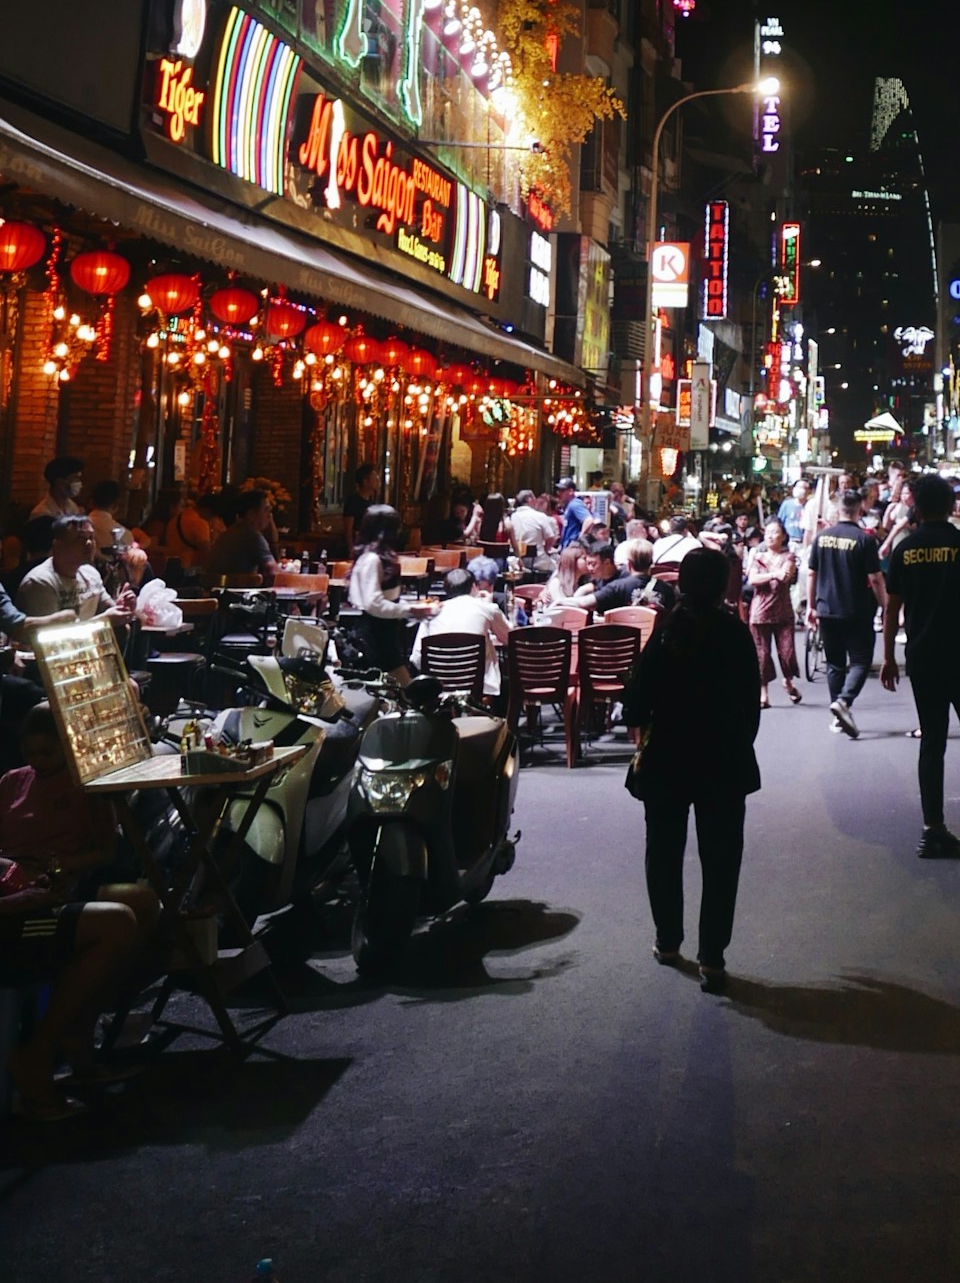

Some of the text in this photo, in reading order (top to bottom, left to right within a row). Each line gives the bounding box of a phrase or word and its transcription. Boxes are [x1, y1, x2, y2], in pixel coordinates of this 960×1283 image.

[159, 58, 205, 143] Tiger
[762, 80, 781, 152] TEL
[357, 131, 416, 235] Saigon
[421, 199, 443, 243] Bar
[484, 257, 502, 300] Tiger
[708, 203, 725, 317] TATTOO
[819, 535, 858, 551] SECURITY
[903, 546, 960, 566] SECURITY
